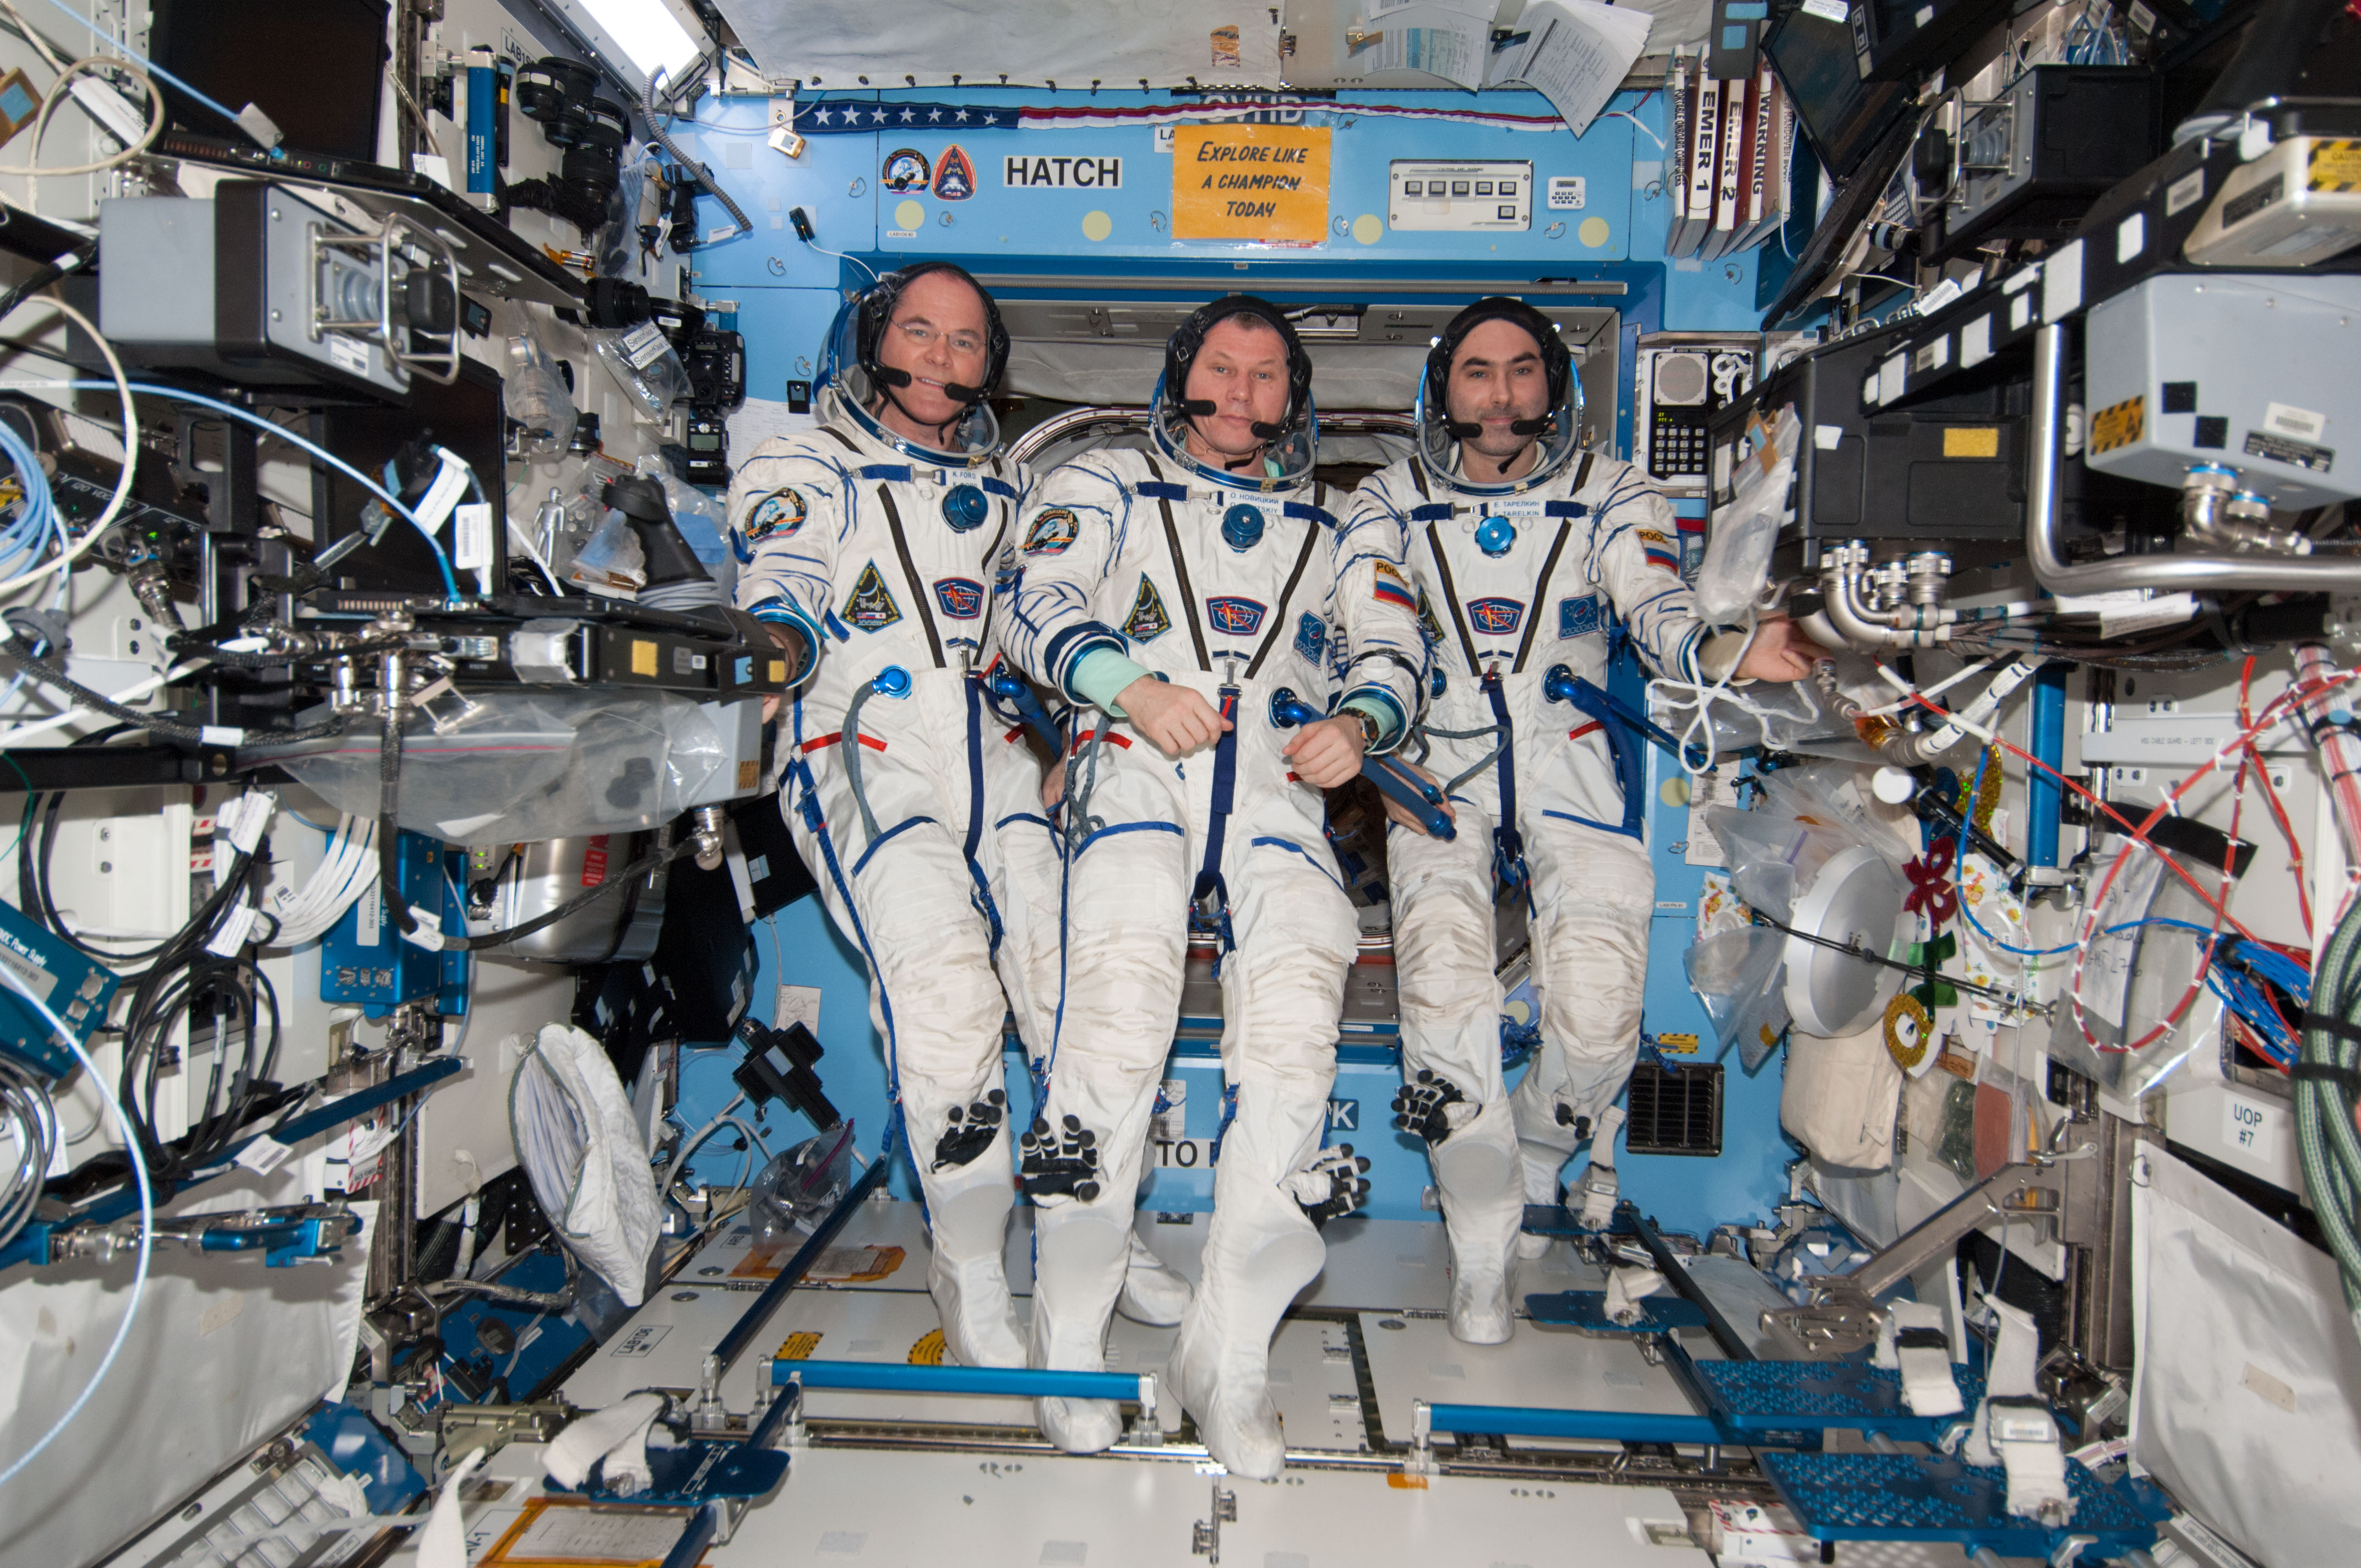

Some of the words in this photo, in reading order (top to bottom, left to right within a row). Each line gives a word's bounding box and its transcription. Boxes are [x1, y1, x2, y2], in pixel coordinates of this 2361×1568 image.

[505, 36, 535, 65] LAB1S
[1698, 91, 1716, 170] EMER
[1724, 101, 1743, 177] EMER
[1197, 141, 1270, 161] EXPLORE
[1273, 146, 1308, 163] LIKE
[1753, 94, 1771, 194] WARNING
[1007, 157, 1119, 187] HATCH
[1201, 175, 1212, 189] A
[1218, 174, 1301, 190] CHAMPION
[1696, 179, 1709, 190] 1
[1722, 186, 1734, 201] 2
[1227, 202, 1276, 217] TODAY
[1239, 493, 1279, 504] НОВИЦКИЙ
[28, 948, 47, 968] Supply
[2234, 1103, 2262, 1128] UOP
[2239, 1128, 2254, 1148] #7
[1156, 1141, 1198, 1167] TO
